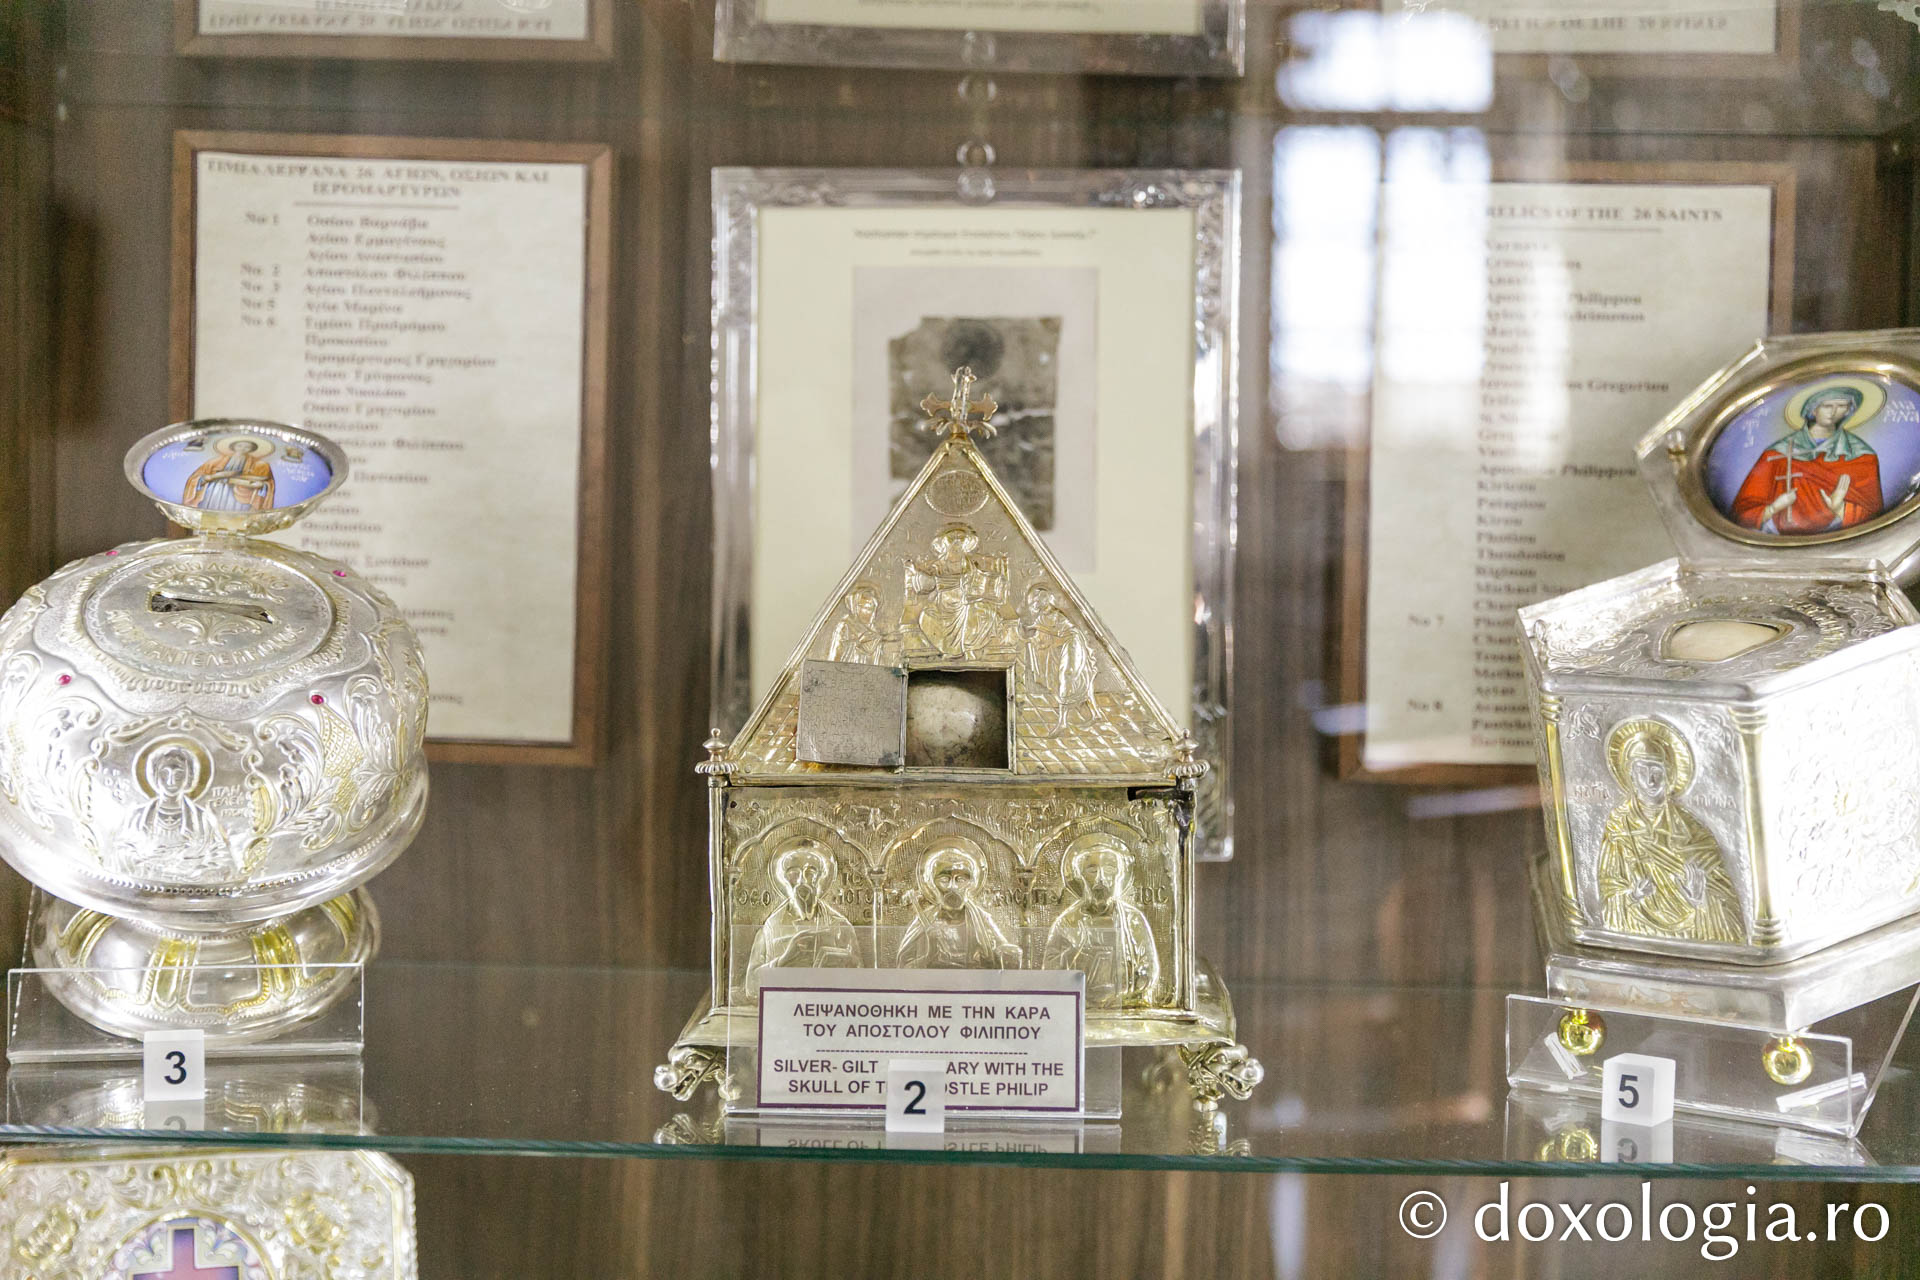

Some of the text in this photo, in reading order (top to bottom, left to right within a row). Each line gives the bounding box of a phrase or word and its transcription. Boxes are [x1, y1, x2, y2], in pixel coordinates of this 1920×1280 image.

[793, 1004, 1051, 1020] ΛΕΙΨΑΝΟΘΗΚΗ ΜΕ ΤΗΝ ΚΑΡΑ
[803, 1023, 1041, 1040] ΤΟΥ ΑΠΟΣΤΟΛΟΥ ΦΙΛΙΠΠΟΥ
[164, 1050, 187, 1085] 3
[842, 1059, 878, 1075] GILT
[984, 1061, 1030, 1076] WITH
[1032, 1062, 1064, 1077] THE
[788, 1079, 843, 1094] SKULL
[847, 1080, 874, 1095] OF
[996, 1081, 1049, 1096] PHILIP
[1617, 1074, 1640, 1109] 5
[903, 1080, 927, 1115] 2
